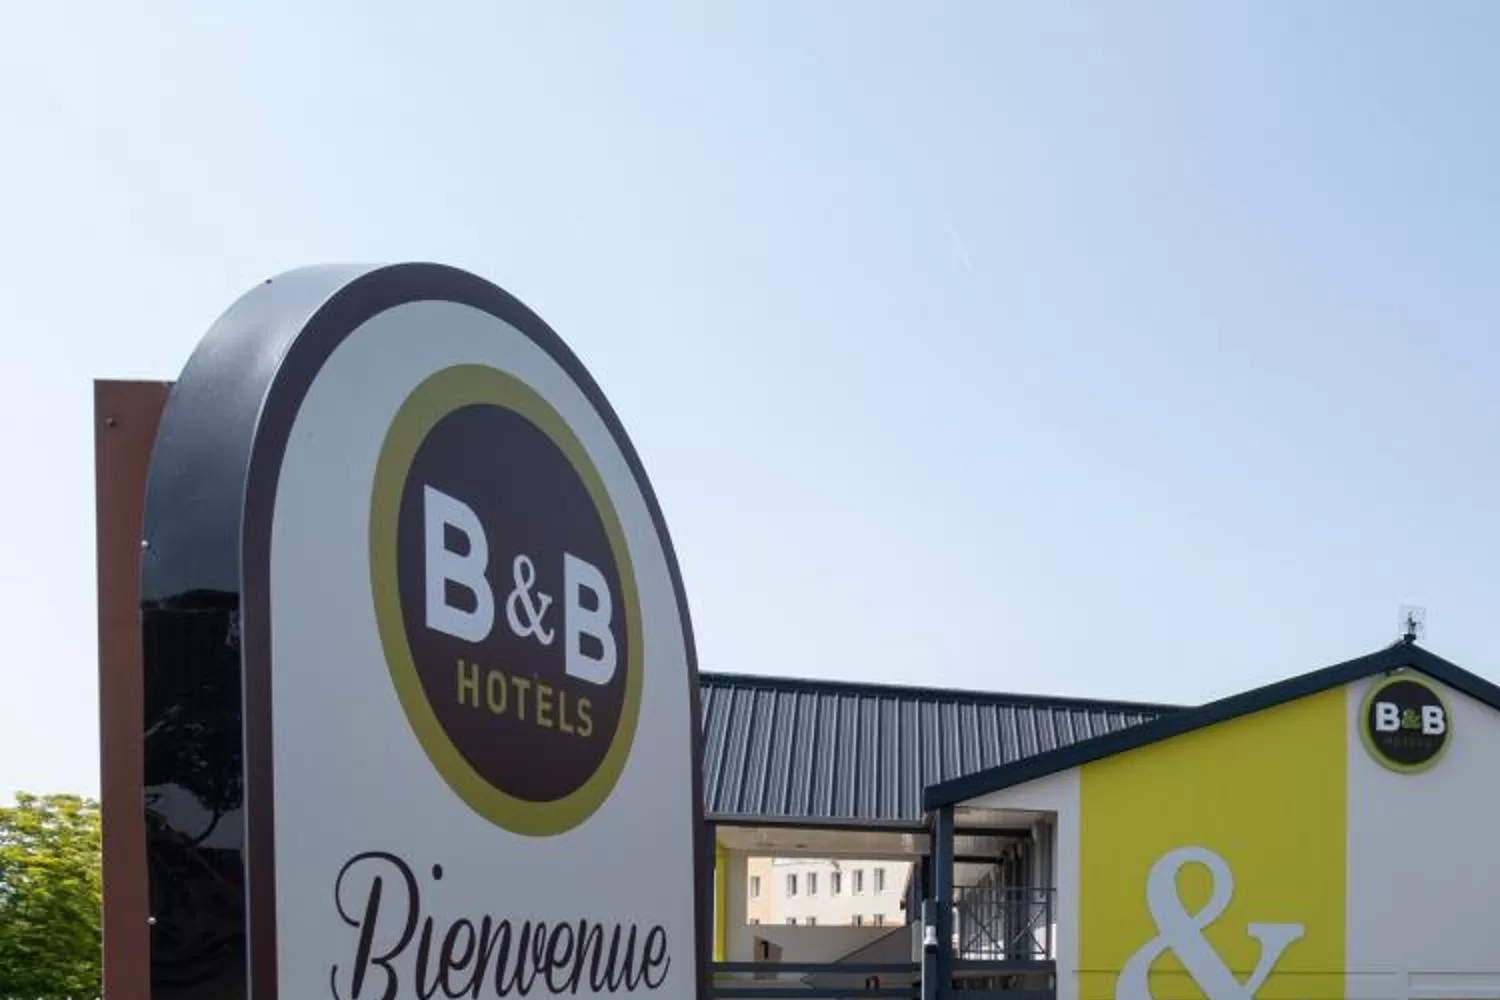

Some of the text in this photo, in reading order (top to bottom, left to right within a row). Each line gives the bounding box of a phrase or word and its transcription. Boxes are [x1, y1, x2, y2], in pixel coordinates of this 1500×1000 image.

[424, 484, 618, 686] B&B
[456, 659, 593, 737] HOTELS
[1376, 702, 1445, 735] B&B
